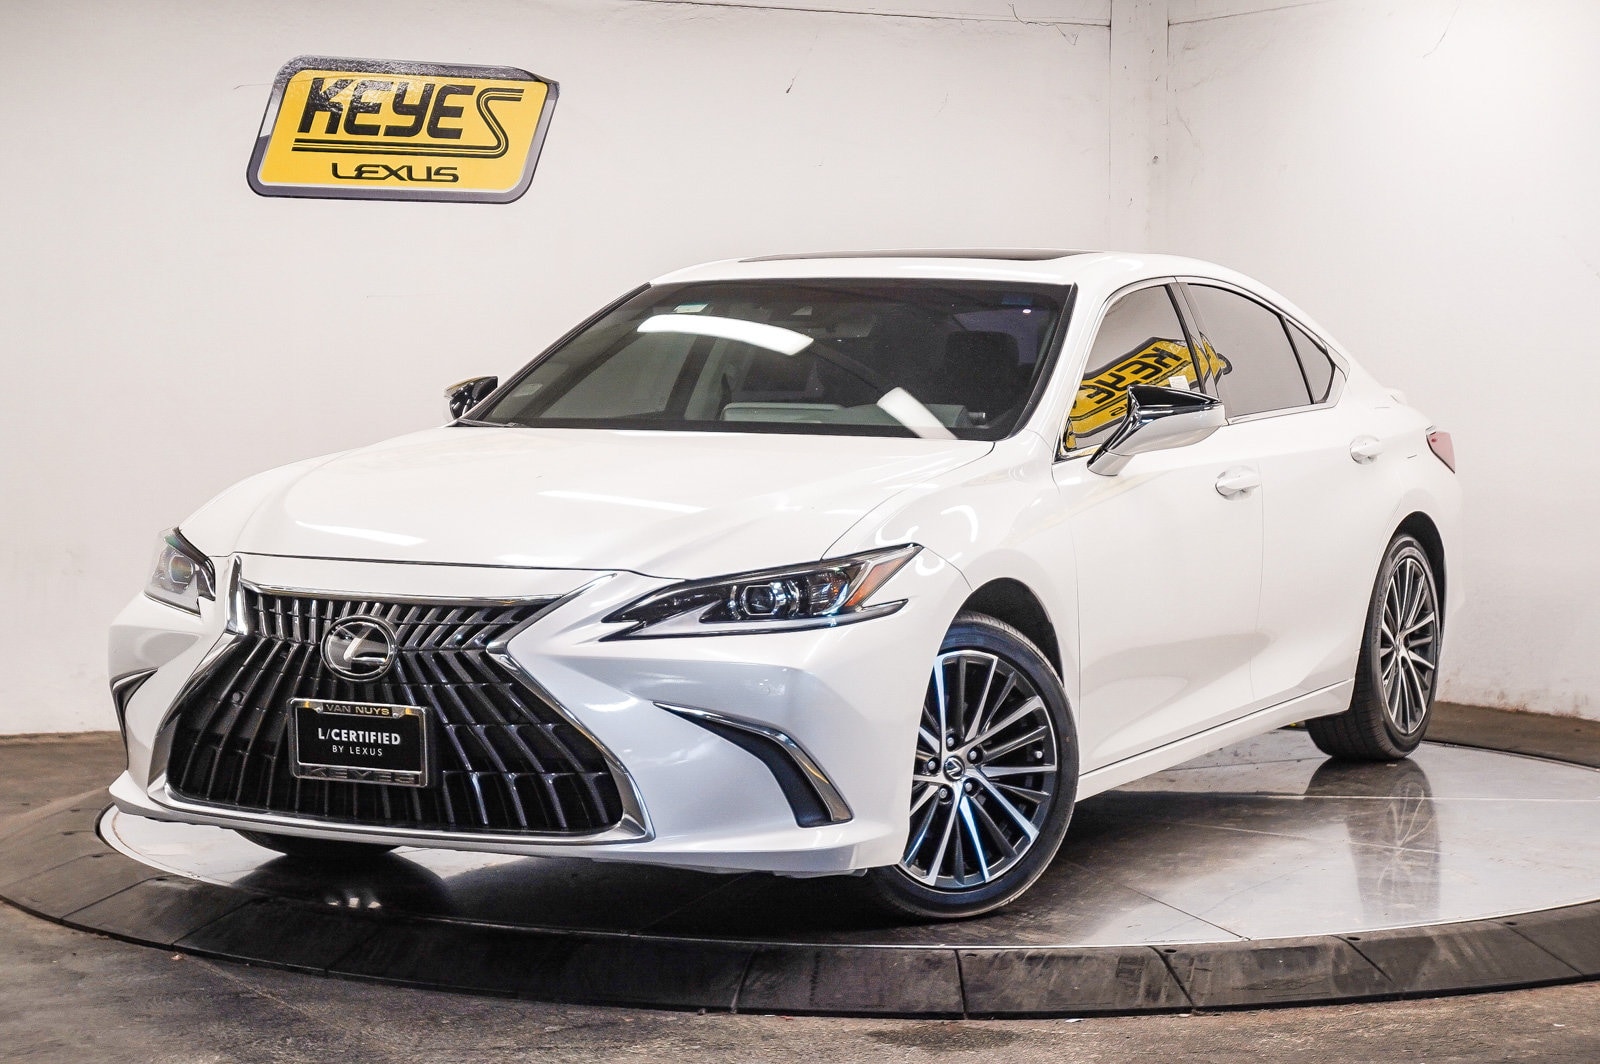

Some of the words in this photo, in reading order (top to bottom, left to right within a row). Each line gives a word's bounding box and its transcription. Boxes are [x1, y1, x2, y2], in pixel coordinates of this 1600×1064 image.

[292, 77, 525, 159] KEYES
[331, 162, 459, 183] LEXUS
[325, 703, 351, 715] VAN
[355, 705, 390, 716] NUYS
[317, 727, 401, 745] L/CERTIFIED
[332, 744, 345, 753] BY
[349, 746, 383, 757] LEXUS
